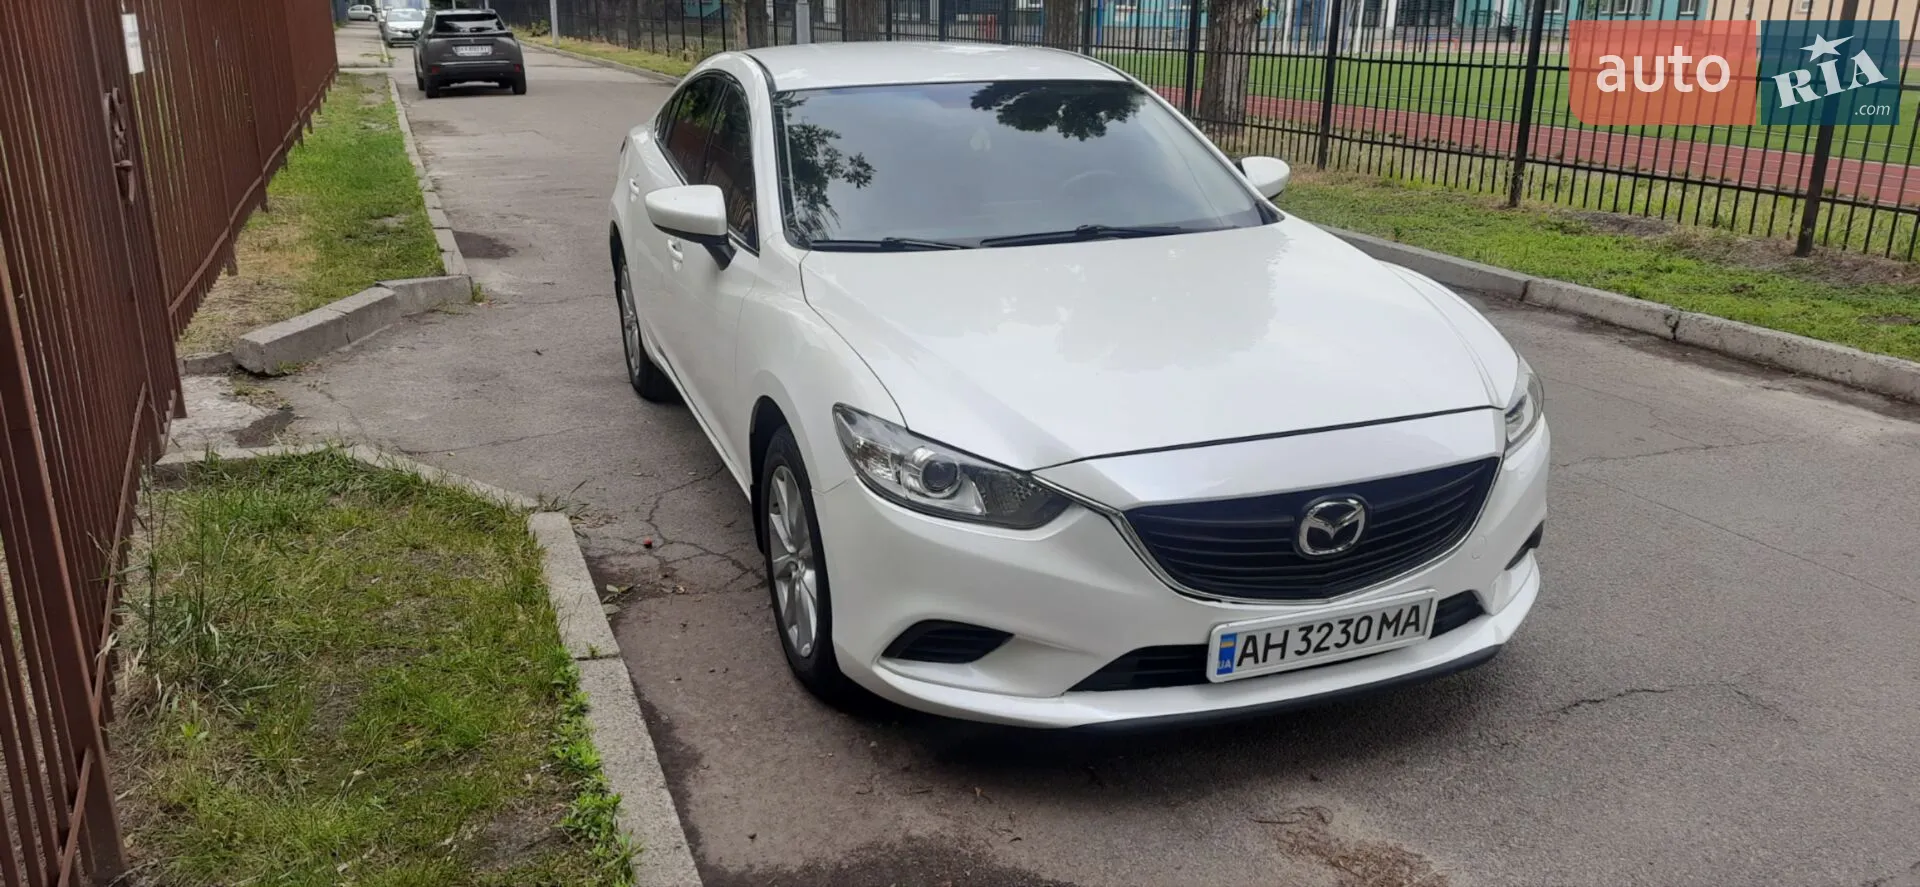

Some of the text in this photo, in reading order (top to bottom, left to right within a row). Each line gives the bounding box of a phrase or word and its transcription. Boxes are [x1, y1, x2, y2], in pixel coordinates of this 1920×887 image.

[1237, 605, 1421, 667] AH 3230 MA
[1217, 660, 1232, 670] UA
